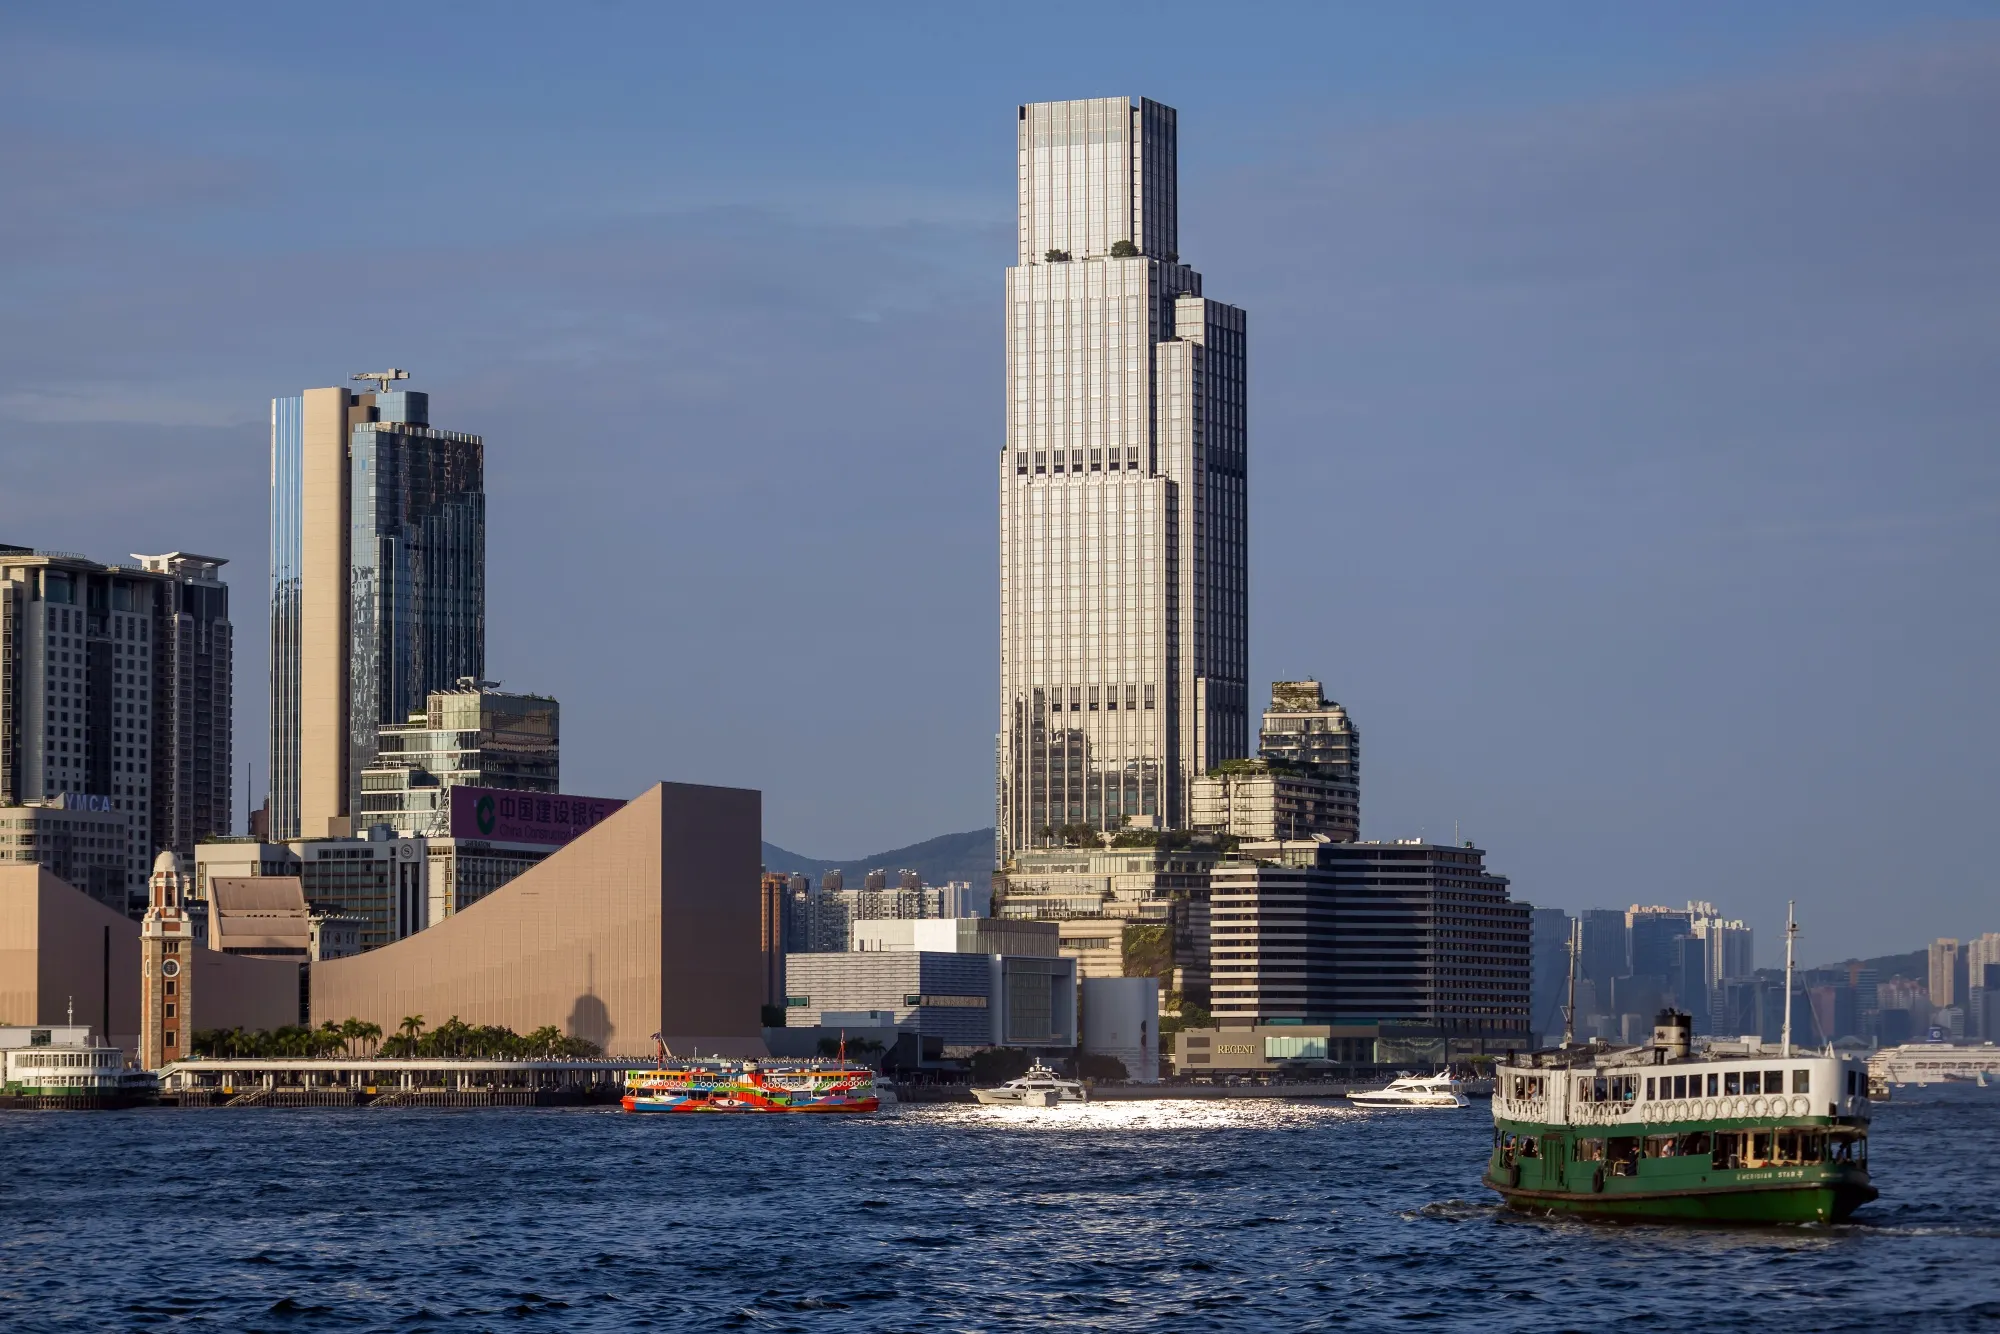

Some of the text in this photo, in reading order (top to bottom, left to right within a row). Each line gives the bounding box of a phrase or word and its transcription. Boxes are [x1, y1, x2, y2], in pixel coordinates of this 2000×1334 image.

[65, 793, 110, 812] YMCA
[500, 797, 604, 826] 中国建设银行
[499, 824, 522, 837] China
[465, 840, 491, 848] SHERATON
[1217, 1044, 1256, 1054] REGENT
